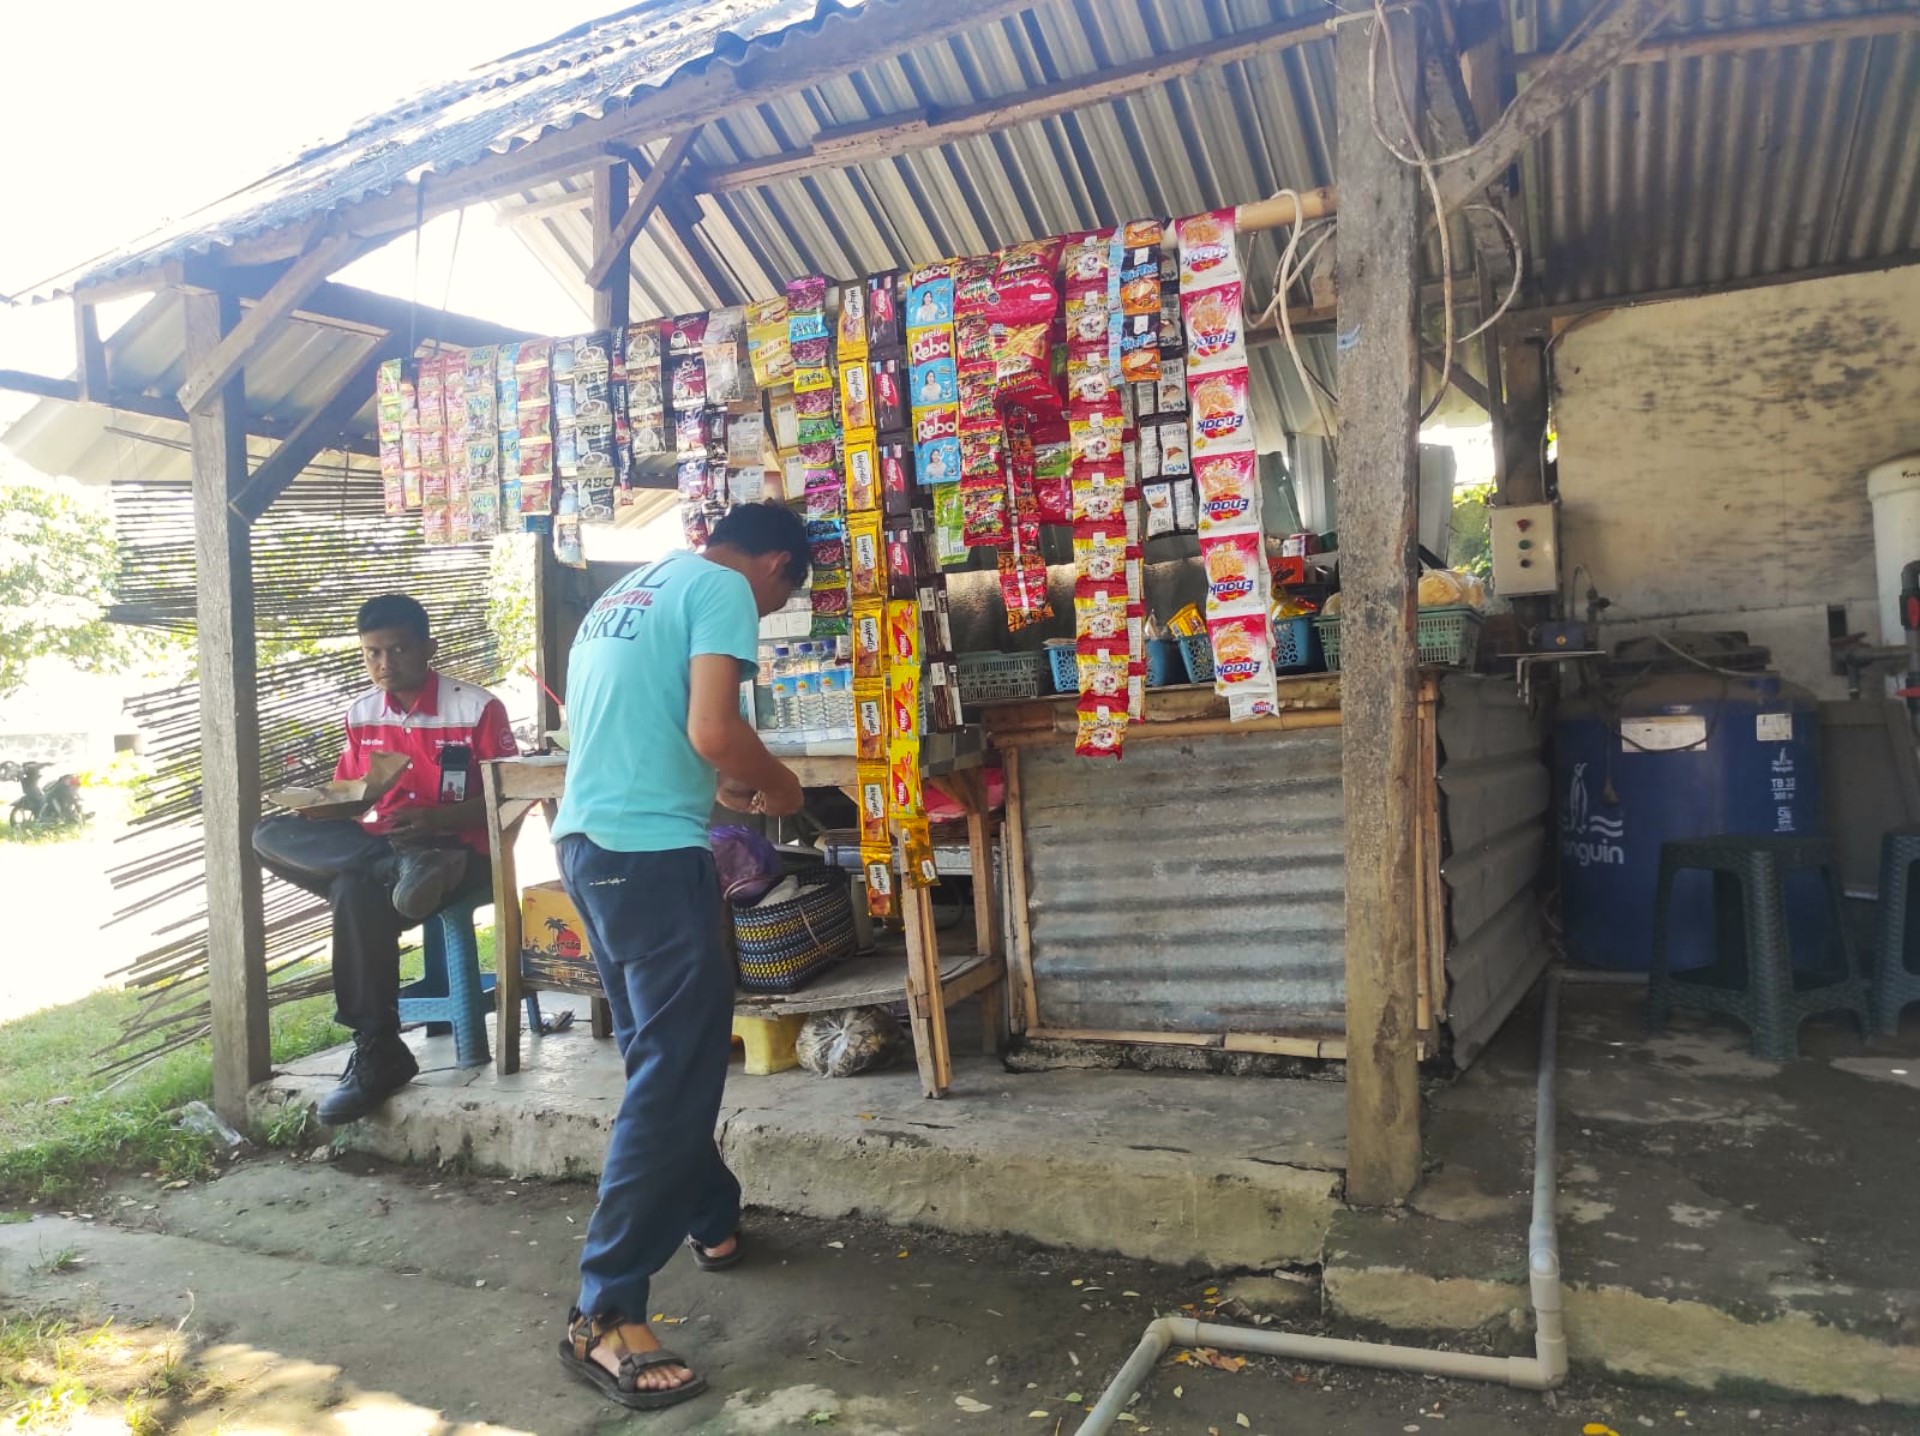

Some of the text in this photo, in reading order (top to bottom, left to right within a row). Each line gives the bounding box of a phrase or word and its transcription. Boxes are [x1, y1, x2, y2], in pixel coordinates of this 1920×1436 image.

[912, 337, 950, 364] Rebo
[581, 425, 611, 436] ABC
[917, 418, 956, 441] Rebo
[1197, 415, 1243, 433] Enaak
[582, 477, 612, 488] ABC
[1201, 498, 1249, 515] Enaak
[1209, 579, 1254, 596] Enaak
[1216, 661, 1261, 677] Enaak
